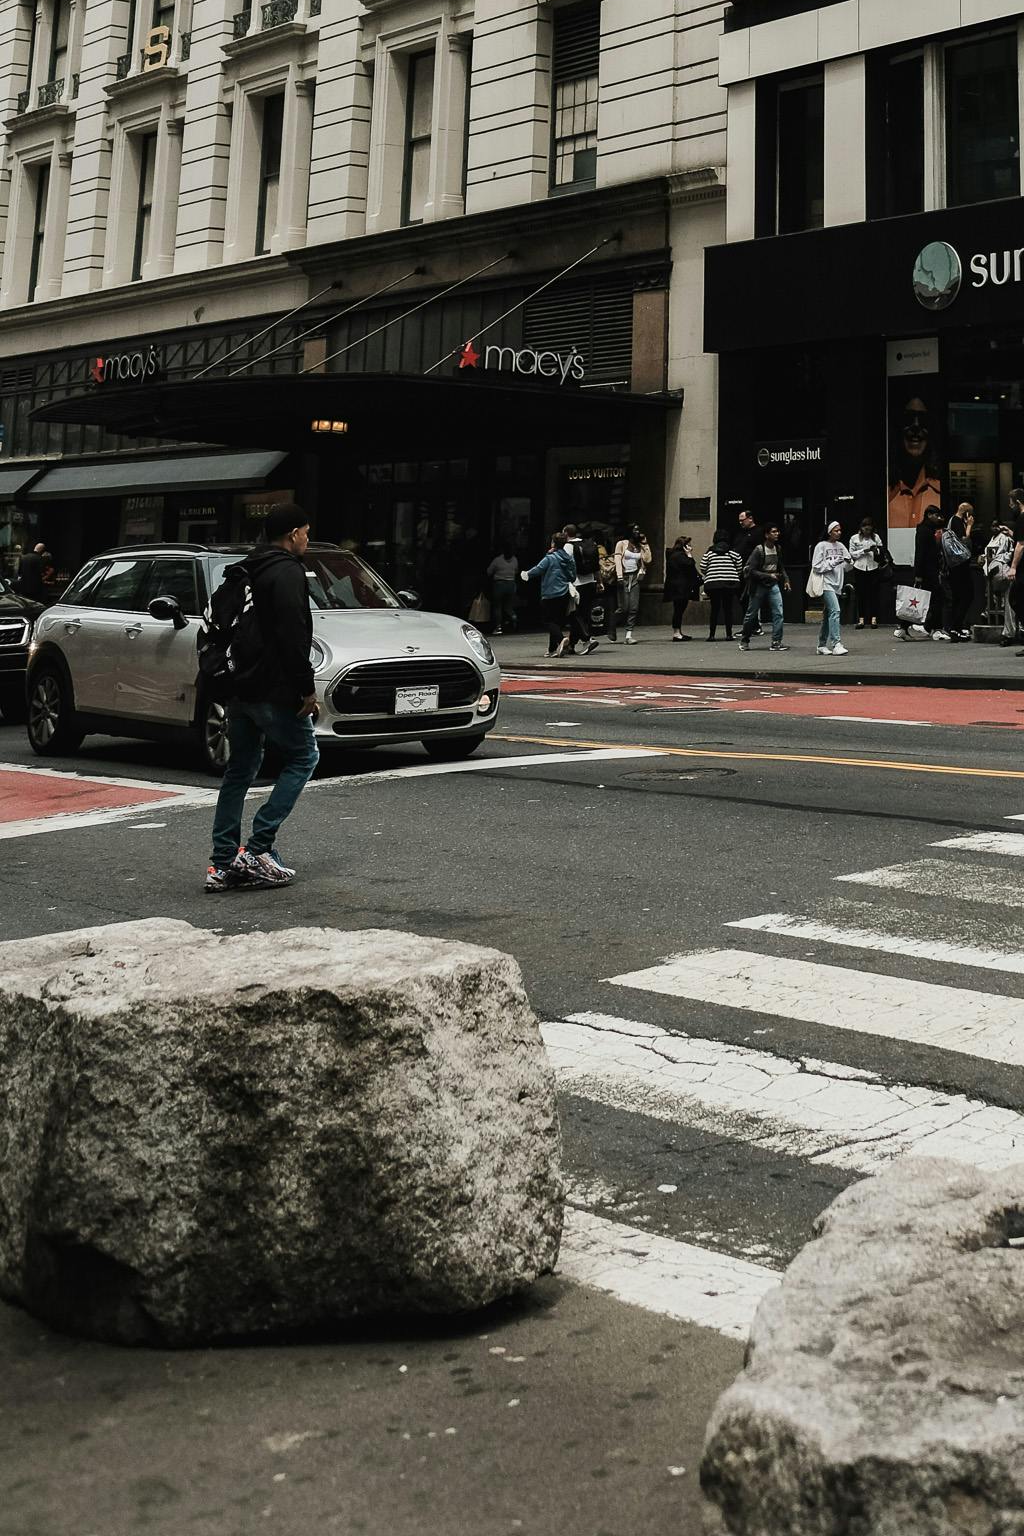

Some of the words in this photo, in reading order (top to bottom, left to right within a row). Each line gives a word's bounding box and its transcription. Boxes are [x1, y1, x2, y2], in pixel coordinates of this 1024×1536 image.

[144, 25, 169, 72] S
[770, 447, 806, 465] sunglass
[806, 446, 821, 460] hut
[568, 468, 591, 480] LOUIS
[592, 467, 626, 478] VUITTON
